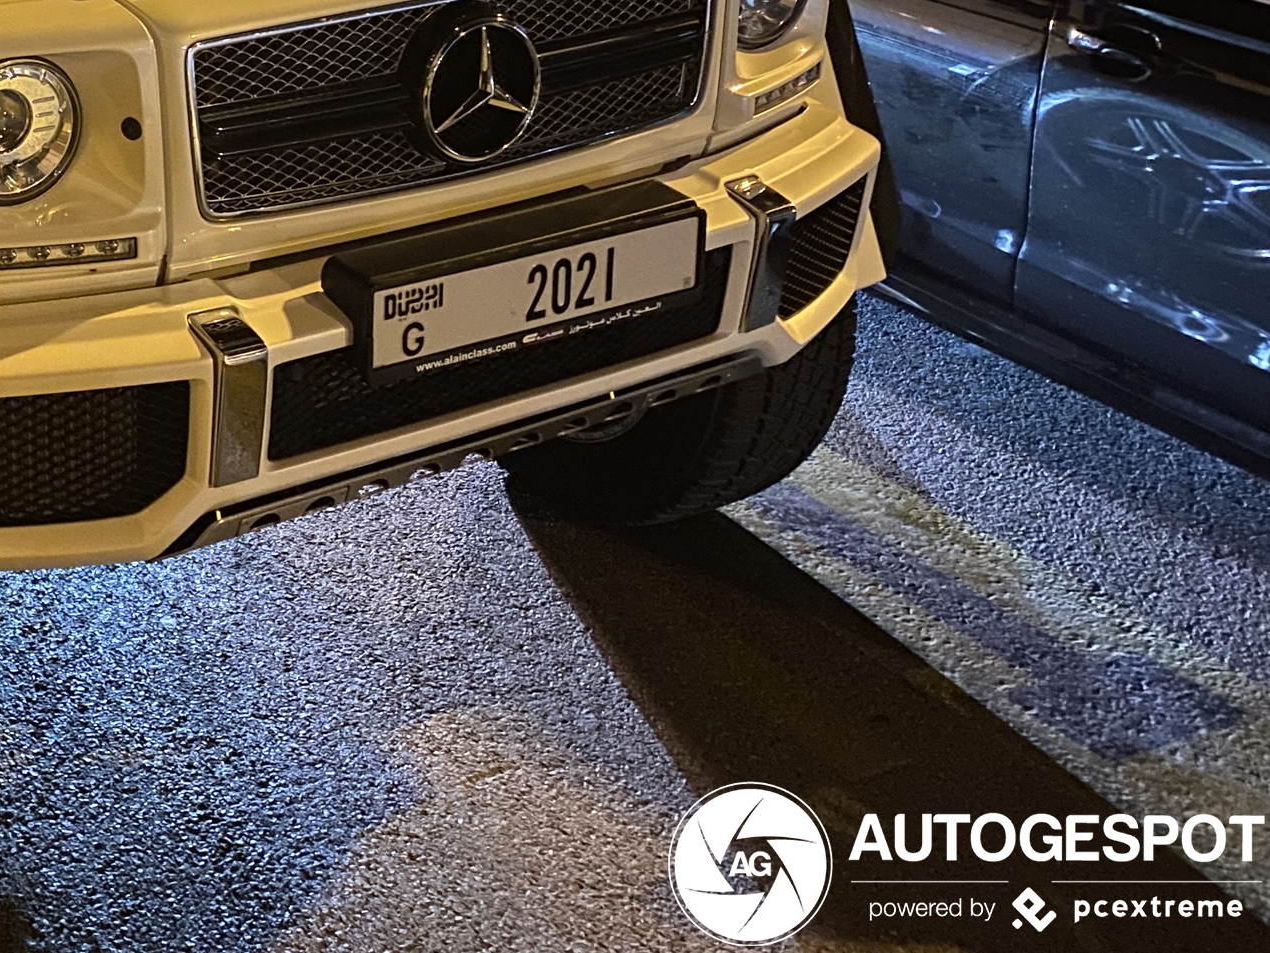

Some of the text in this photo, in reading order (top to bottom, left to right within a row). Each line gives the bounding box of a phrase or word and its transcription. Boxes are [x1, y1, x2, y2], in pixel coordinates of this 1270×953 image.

[525, 247, 615, 322] 2021
[401, 321, 425, 357] G
[416, 340, 517, 373] www.alainclass.com
